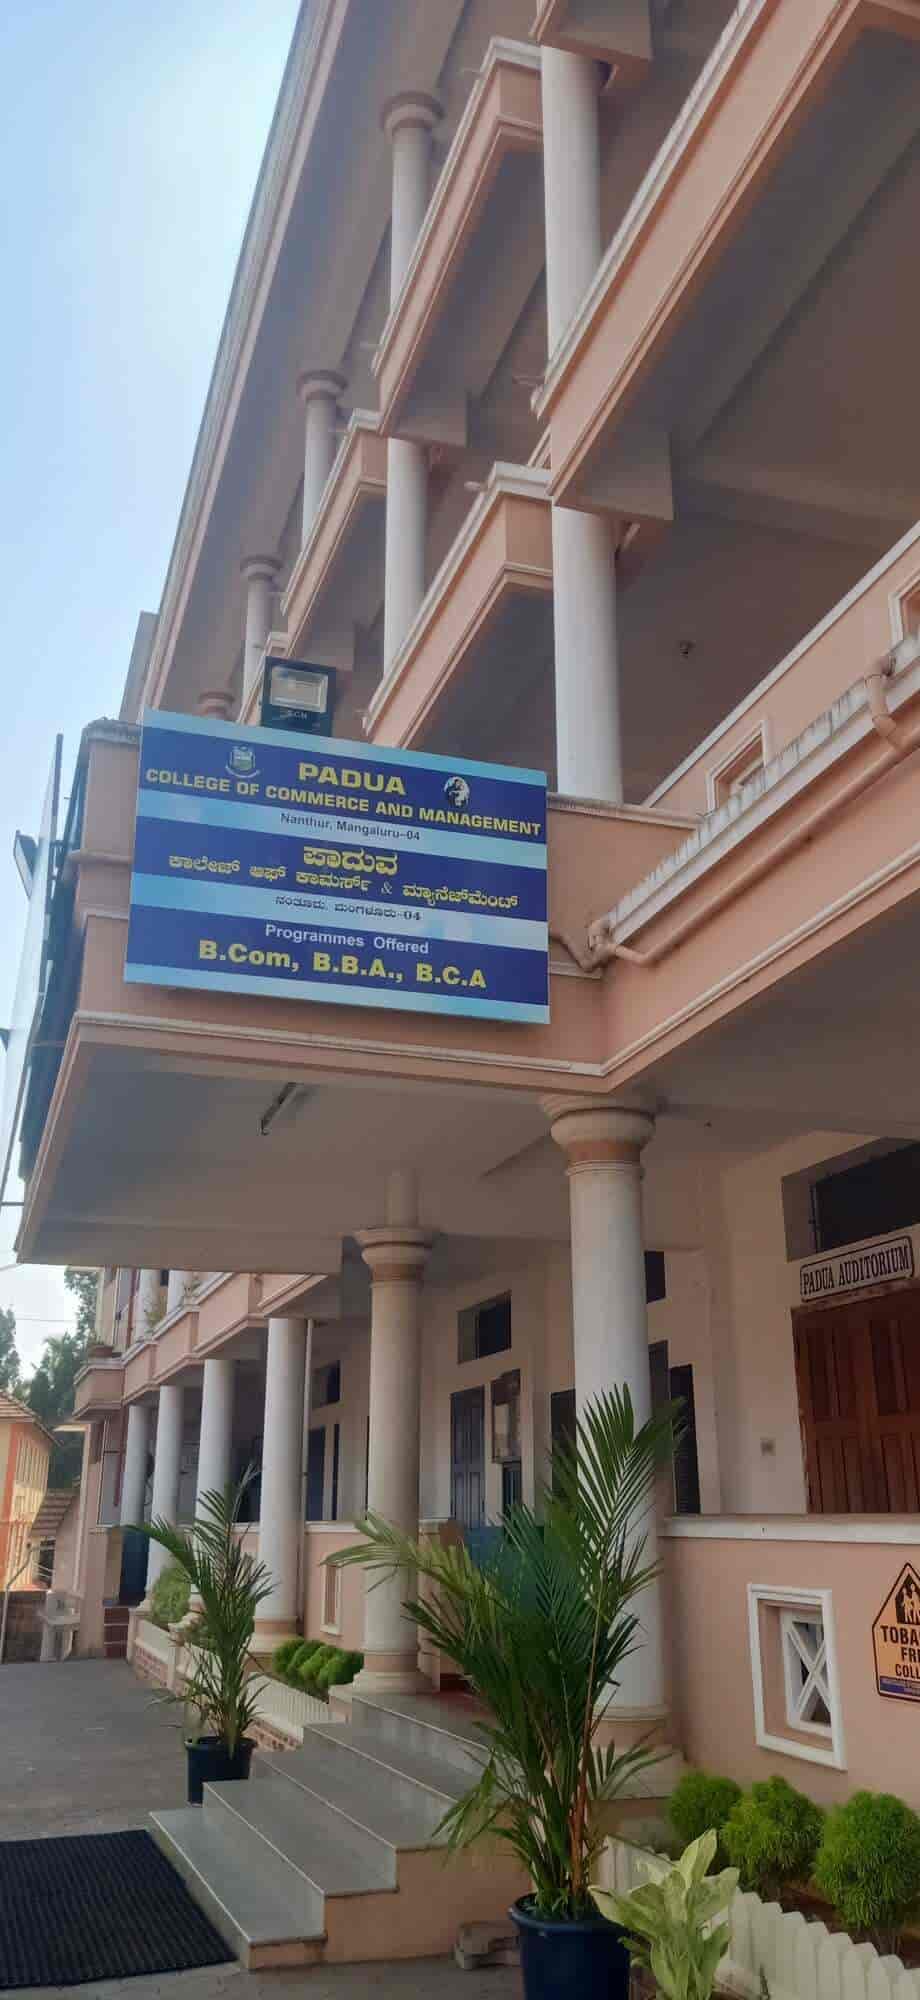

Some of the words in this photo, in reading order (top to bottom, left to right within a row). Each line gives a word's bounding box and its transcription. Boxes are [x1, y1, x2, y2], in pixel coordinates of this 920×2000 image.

[298, 762, 406, 795] PADUA
[145, 768, 231, 793] COLLEGE
[236, 781, 260, 796] OF
[265, 785, 369, 813] COMMERCE
[375, 800, 414, 818] AND
[419, 806, 542, 837] MANAGEMENT
[280, 812, 333, 831] Nanthur,
[303, 846, 399, 876] ಪಾದುವ
[381, 881, 393, 896] &
[265, 923, 365, 947] Programmes
[373, 936, 430, 954] Offered
[199, 939, 300, 973] B.Com,
[312, 951, 404, 984] B.B.A.,
[415, 962, 488, 989] B.C.A
[803, 1265, 835, 1296] PADUA
[839, 1245, 909, 1285] AUDITORIUM
[880, 1625, 920, 1646] TOBA
